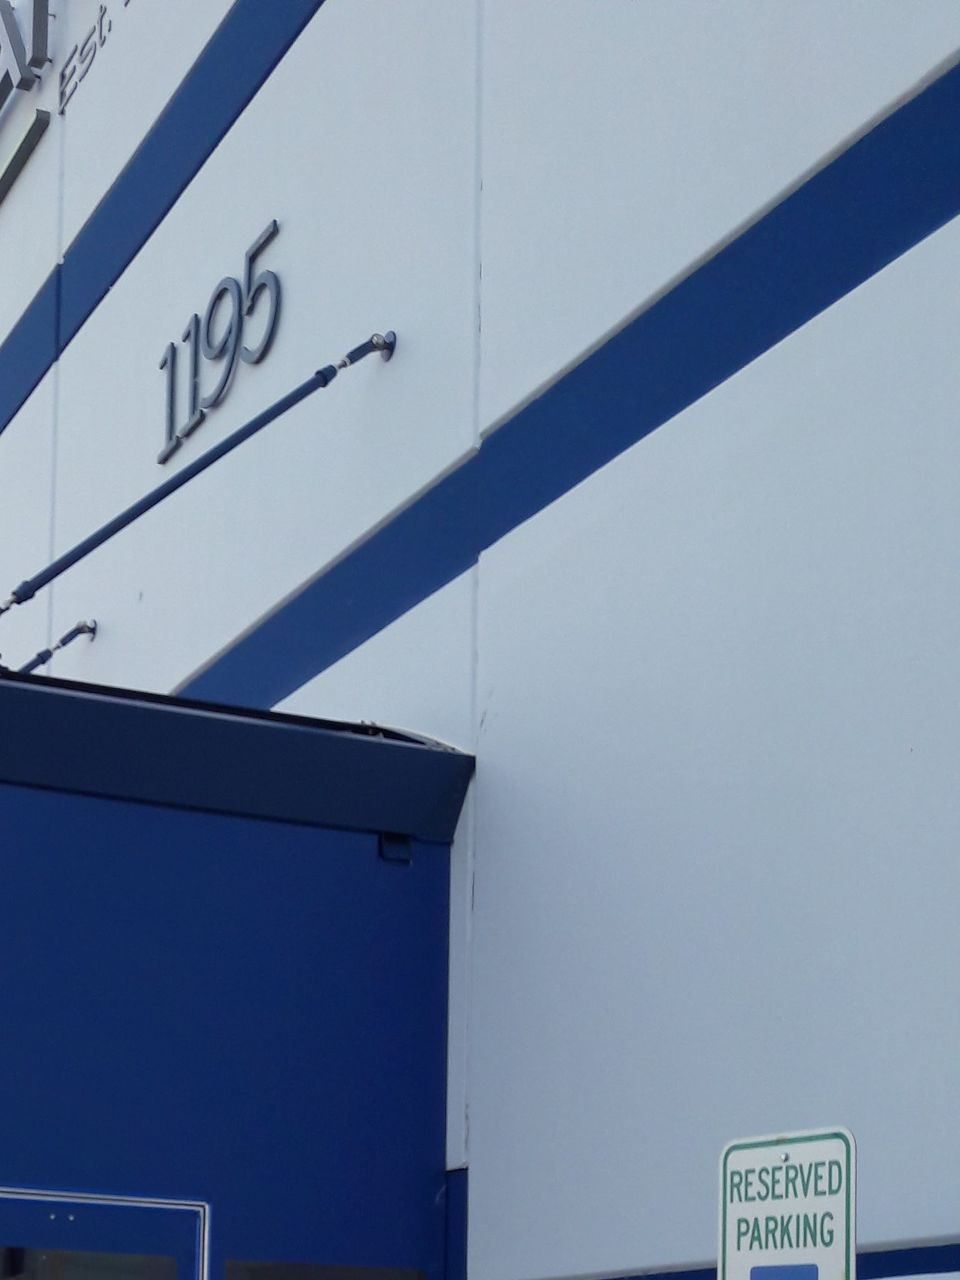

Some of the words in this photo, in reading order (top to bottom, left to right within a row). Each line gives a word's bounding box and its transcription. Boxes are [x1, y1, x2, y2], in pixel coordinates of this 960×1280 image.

[58, 4, 113, 116] Est.
[157, 219, 282, 465] 1195
[729, 1159, 843, 1203] RESERVED
[736, 1212, 835, 1252] PARKING
